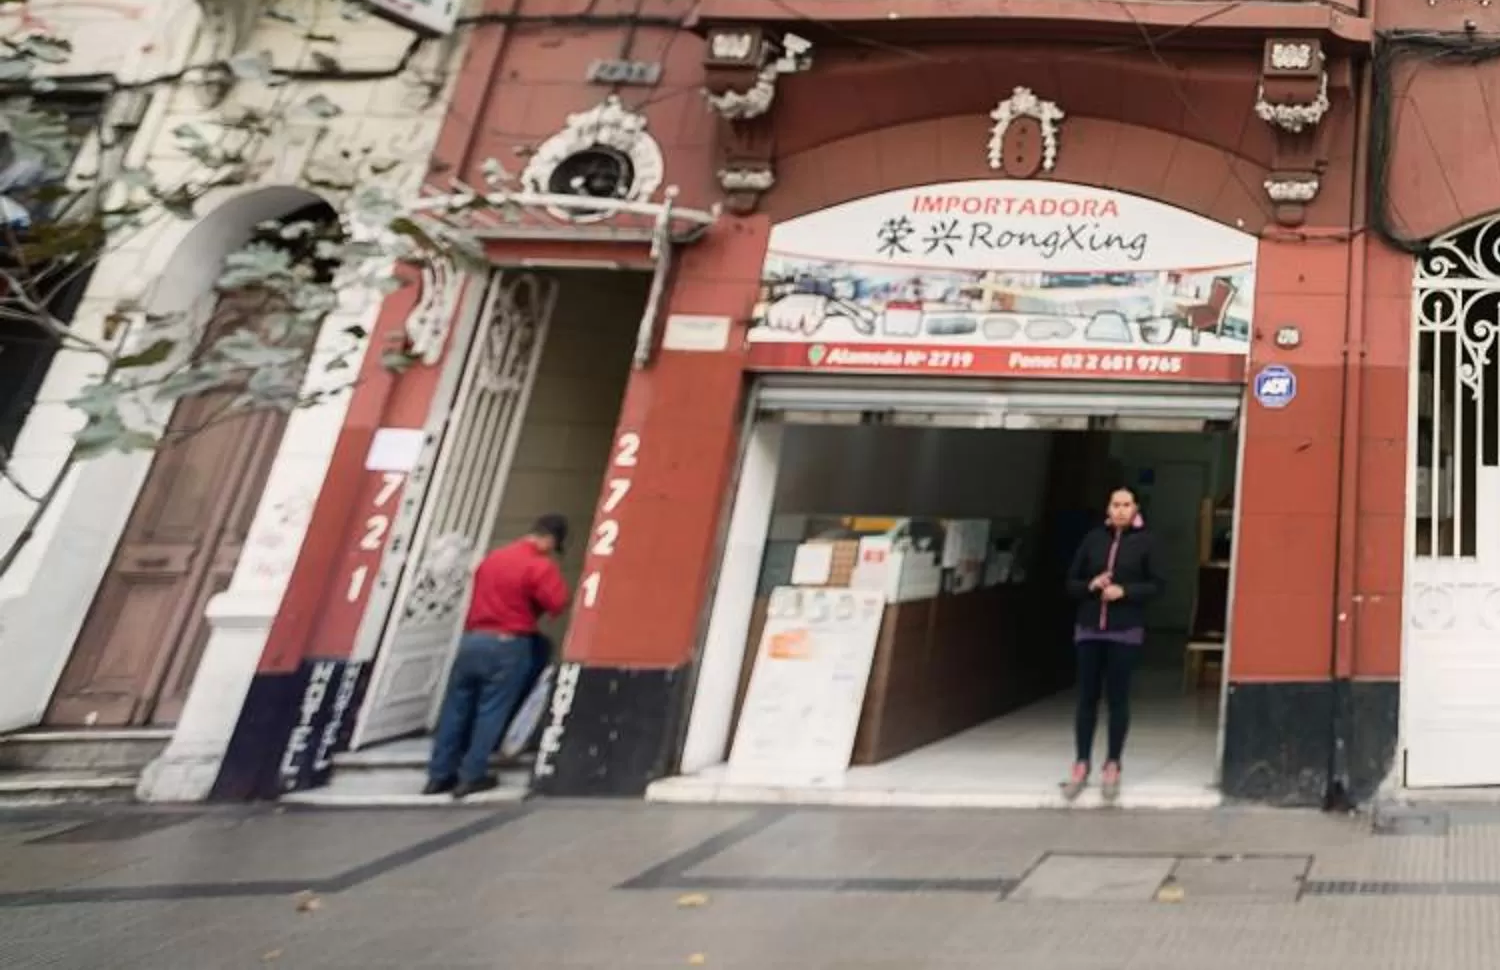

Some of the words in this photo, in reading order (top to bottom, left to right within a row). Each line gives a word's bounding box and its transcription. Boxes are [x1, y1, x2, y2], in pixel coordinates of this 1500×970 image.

[911, 195, 1119, 218] IMPORTADORA
[968, 221, 1148, 261] RongXing
[928, 350, 975, 368] 2719
[1060, 353, 1083, 370] 02
[1085, 353, 1099, 371] 2
[347, 472, 406, 603] 721
[581, 432, 641, 608] 2721
[534, 661, 581, 777] HOTEL
